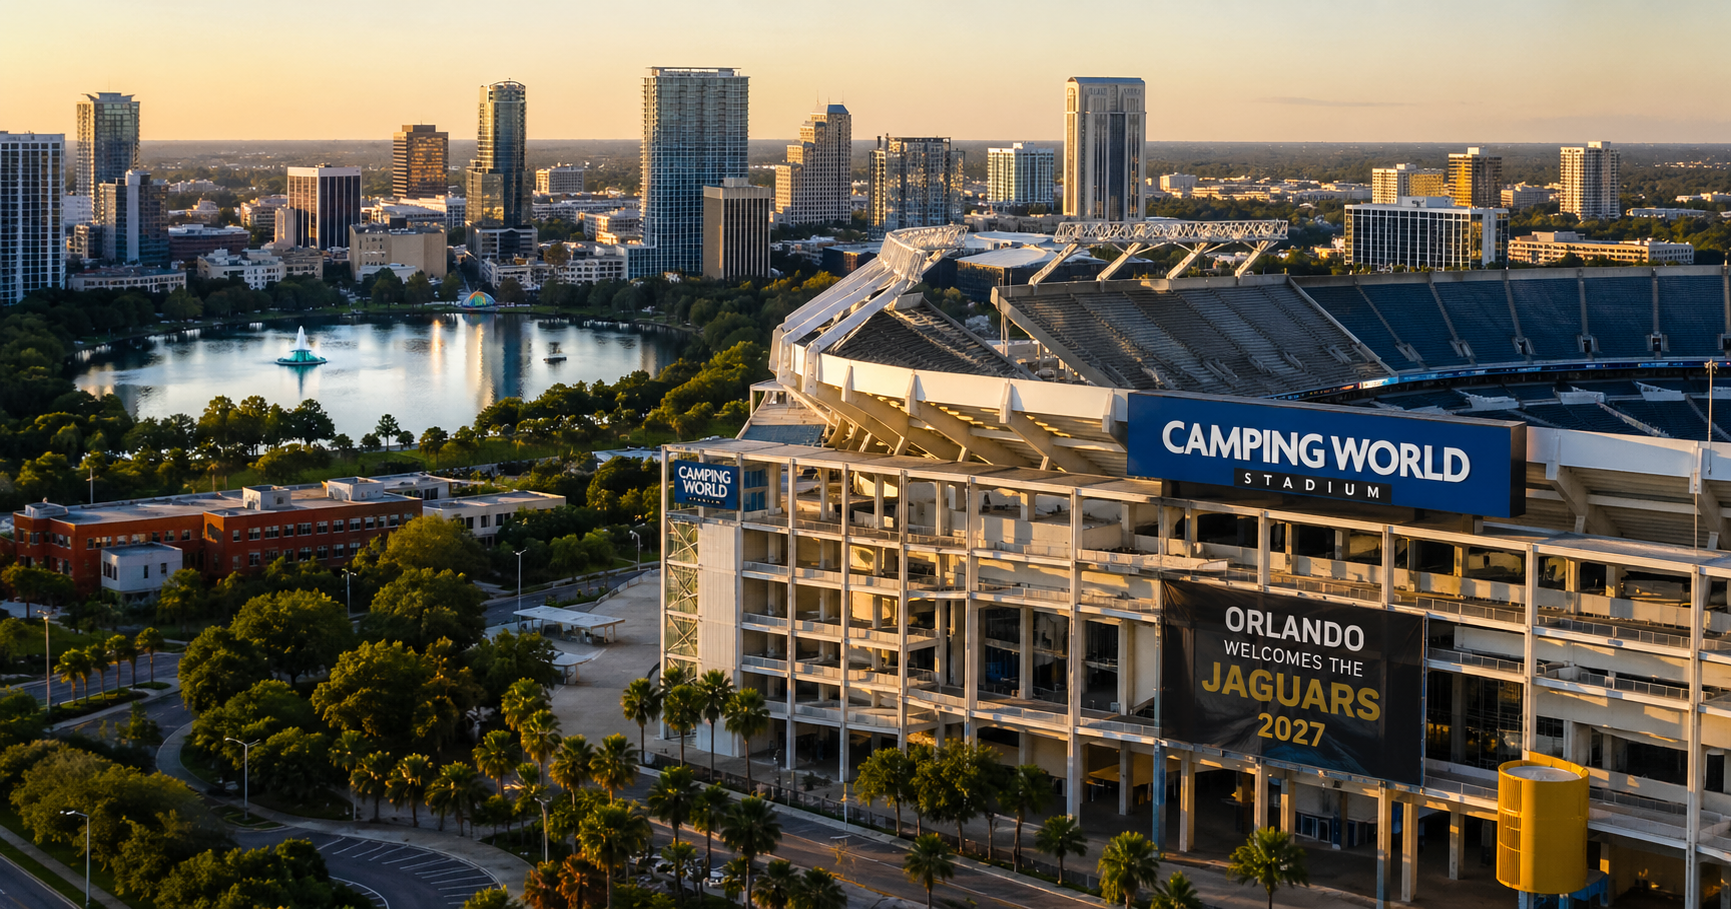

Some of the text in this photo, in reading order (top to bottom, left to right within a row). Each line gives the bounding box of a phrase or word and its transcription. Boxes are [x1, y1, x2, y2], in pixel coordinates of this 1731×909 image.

[1162, 420, 1471, 483] CAMPING WORLD
[678, 465, 731, 484] CAMPING
[683, 480, 728, 498] WORLD
[1244, 472, 1380, 499] STADIUM
[1225, 606, 1365, 652] ORLANDO
[1223, 639, 1364, 678] WELCOMES THE
[1201, 661, 1381, 722] JAGUARS
[1257, 712, 1326, 748] 2027
